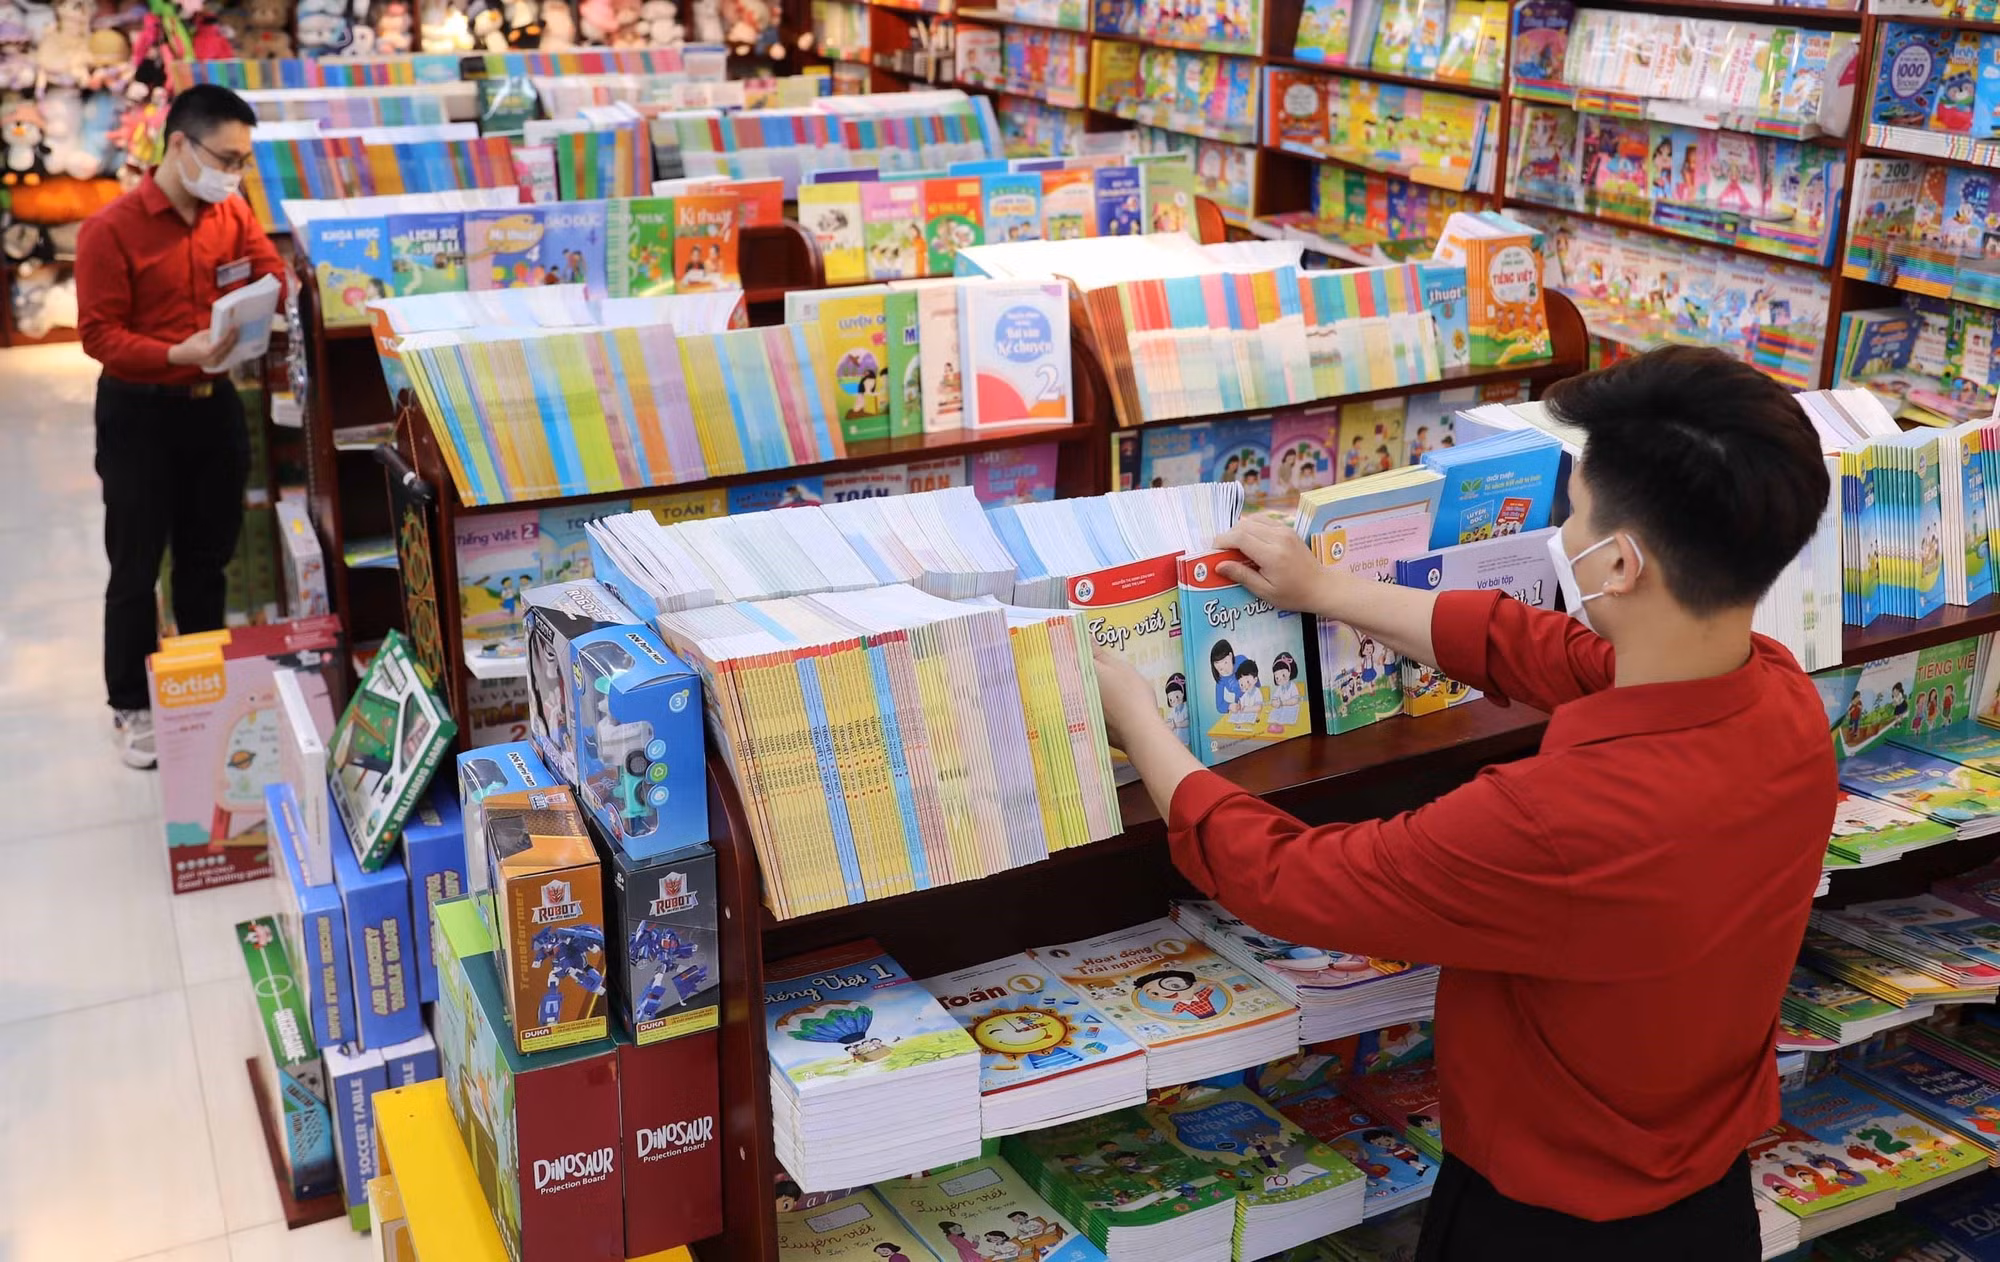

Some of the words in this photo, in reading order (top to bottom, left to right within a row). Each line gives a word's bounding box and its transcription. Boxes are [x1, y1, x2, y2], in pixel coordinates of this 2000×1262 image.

[1899, 63, 1925, 78] 1000
[1885, 162, 1911, 178] 200
[364, 240, 380, 260] 4
[1035, 363, 1062, 401] 2
[910, 474, 952, 494] OÁN
[662, 502, 705, 520] TOÁN
[522, 523, 535, 538] 2
[1362, 560, 1374, 571] bài
[1374, 556, 1390, 570] tập
[1476, 578, 1488, 590] Vở
[1488, 576, 1499, 588] bài
[1499, 574, 1514, 588] tập
[1531, 578, 1544, 606] 1
[1087, 614, 1131, 651] Tập
[1133, 607, 1166, 638] viết
[1168, 601, 1181, 626] 1
[1203, 597, 1241, 631] Tập
[1917, 657, 1953, 683] TIẾNG
[1956, 652, 1977, 671] VIỆ
[675, 697, 683, 708] 3
[1962, 675, 1974, 705] 1
[393, 766, 432, 822] BILLIARDS
[425, 734, 448, 769] GAME
[537, 902, 577, 922] ROBOT
[655, 894, 693, 915] ROBOT
[382, 918, 400, 962] GAME
[514, 886, 529, 991] Transformer
[364, 927, 385, 988] HOCKEY
[1072, 961, 1110, 977] Trải
[1111, 951, 1165, 972] nghiệm
[1082, 954, 1117, 969] Hoạt
[1118, 942, 1154, 960] động
[387, 962, 406, 1012] TABLE
[811, 971, 869, 991] Việt
[869, 963, 894, 980] 1
[1016, 977, 1037, 991] 1
[371, 988, 389, 1016] AIR
[524, 1028, 550, 1039] DUKA
[640, 1020, 664, 1032] DUKA
[350, 1077, 366, 1120] TABLE
[355, 1120, 373, 1176] SOCCER
[643, 1148, 682, 1163] Projection
[683, 1141, 706, 1154] Board
[540, 1180, 581, 1196] Projection
[582, 1173, 607, 1186] Board
